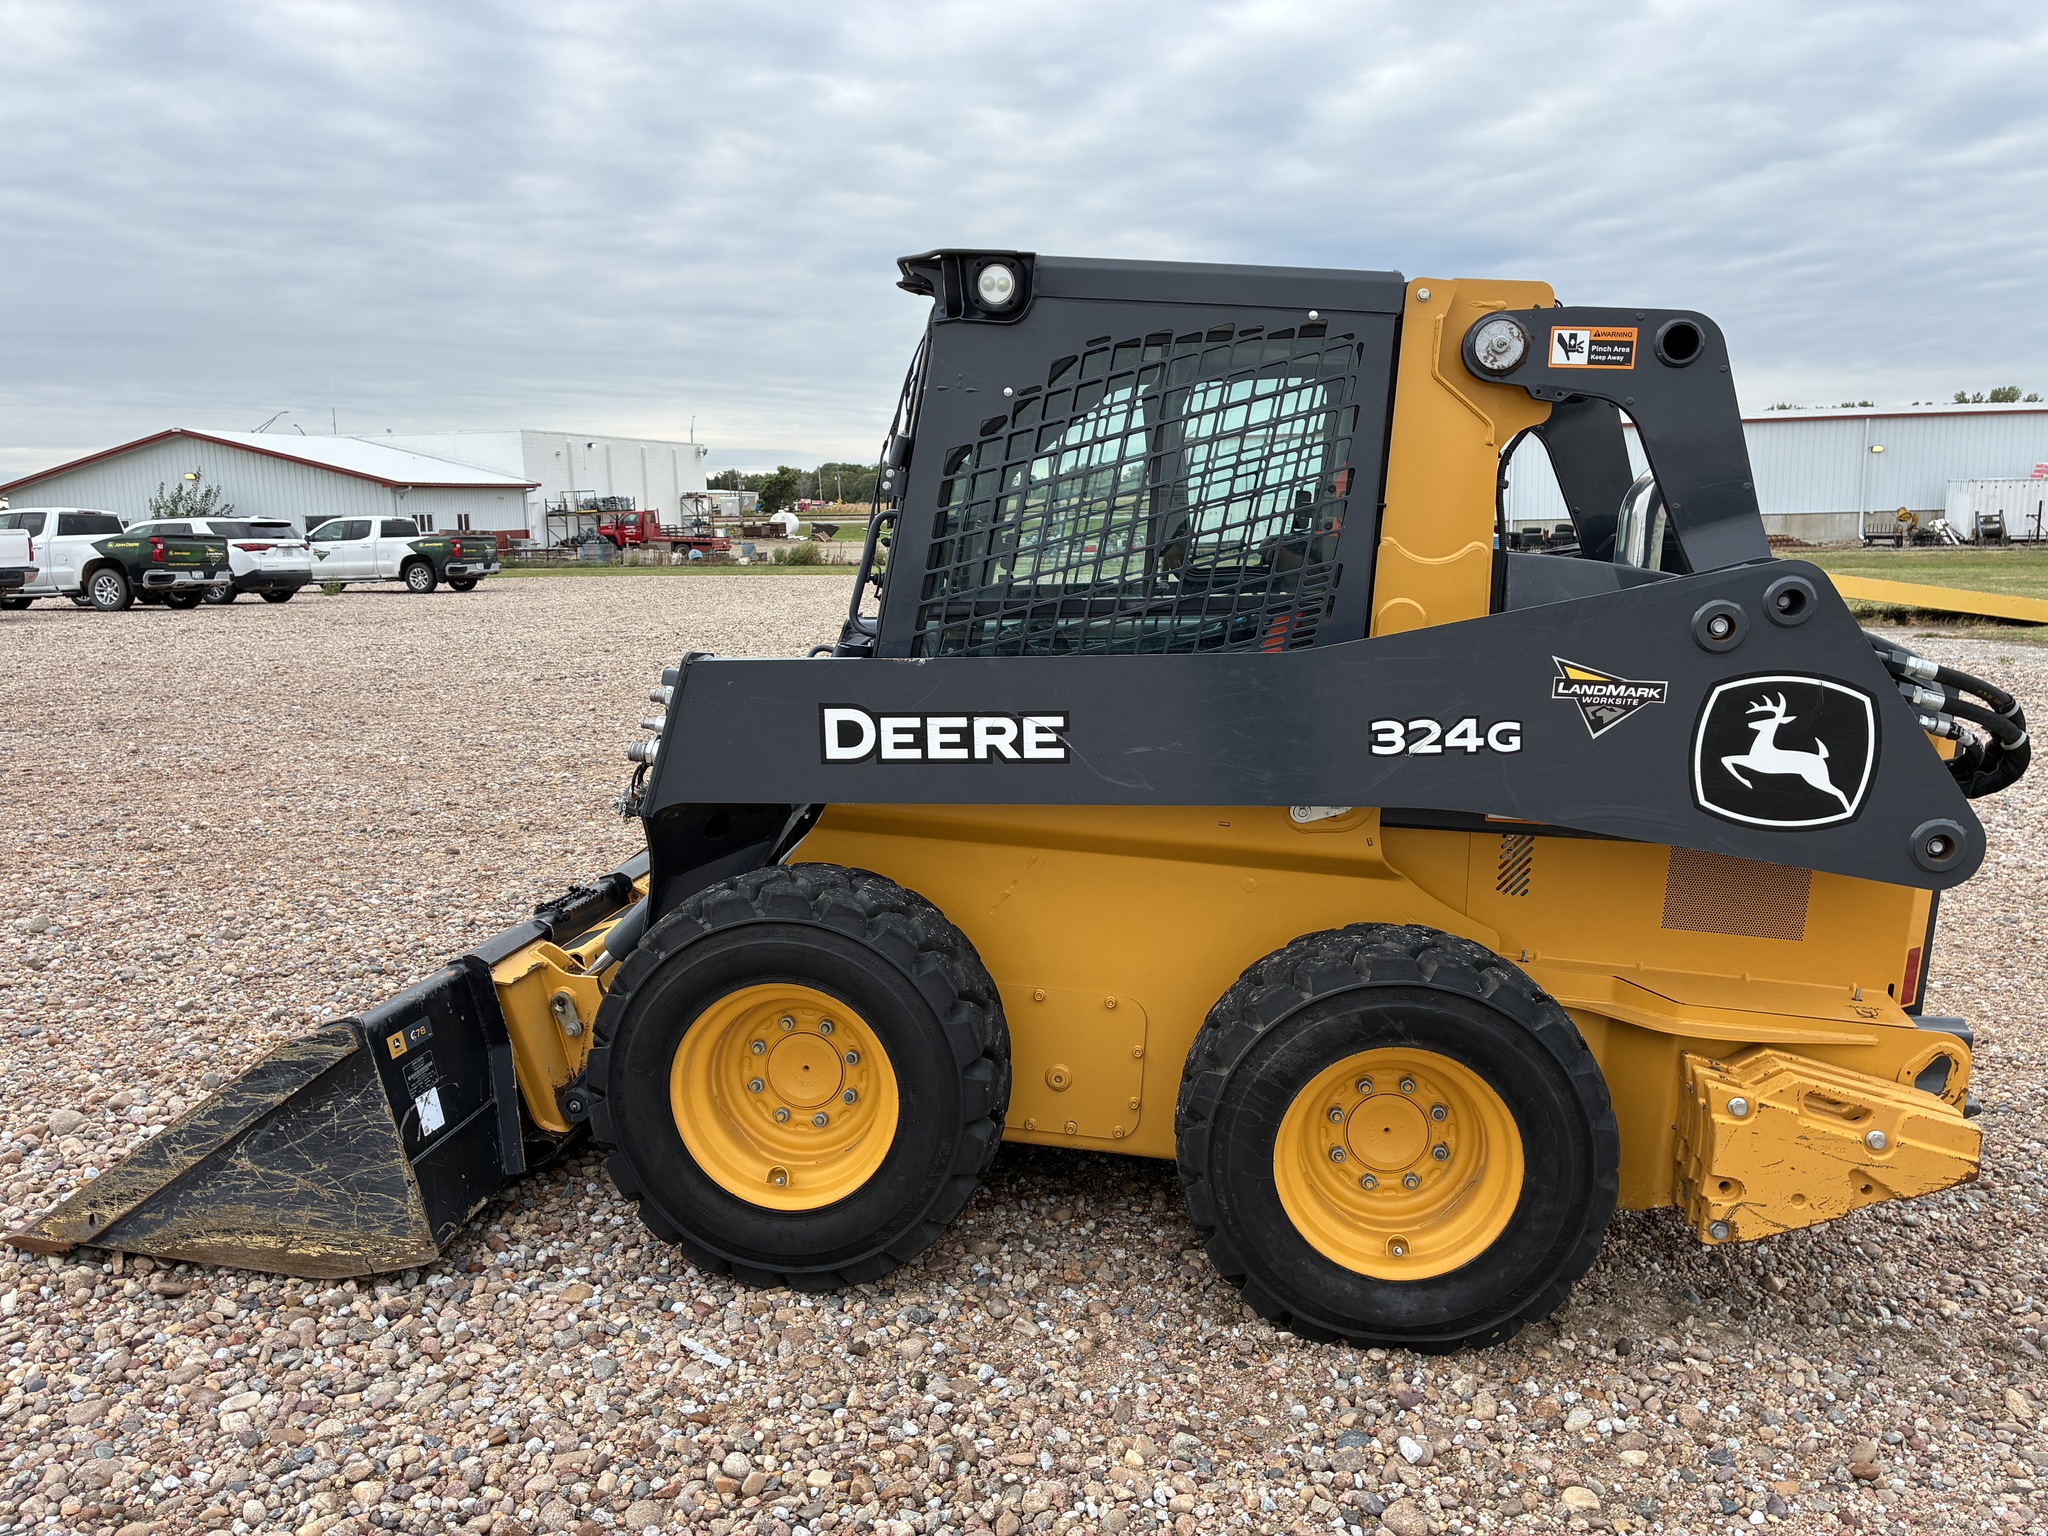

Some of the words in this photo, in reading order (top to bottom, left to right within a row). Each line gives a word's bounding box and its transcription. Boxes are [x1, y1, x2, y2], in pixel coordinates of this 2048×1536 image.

[1591, 345, 1612, 353] Pinch
[1607, 354, 1624, 362] Away
[1557, 682, 1663, 699] LANDMARK
[1581, 696, 1640, 706] WORKSITE
[823, 708, 1066, 760] DEERE
[1371, 718, 1521, 755] 324G
